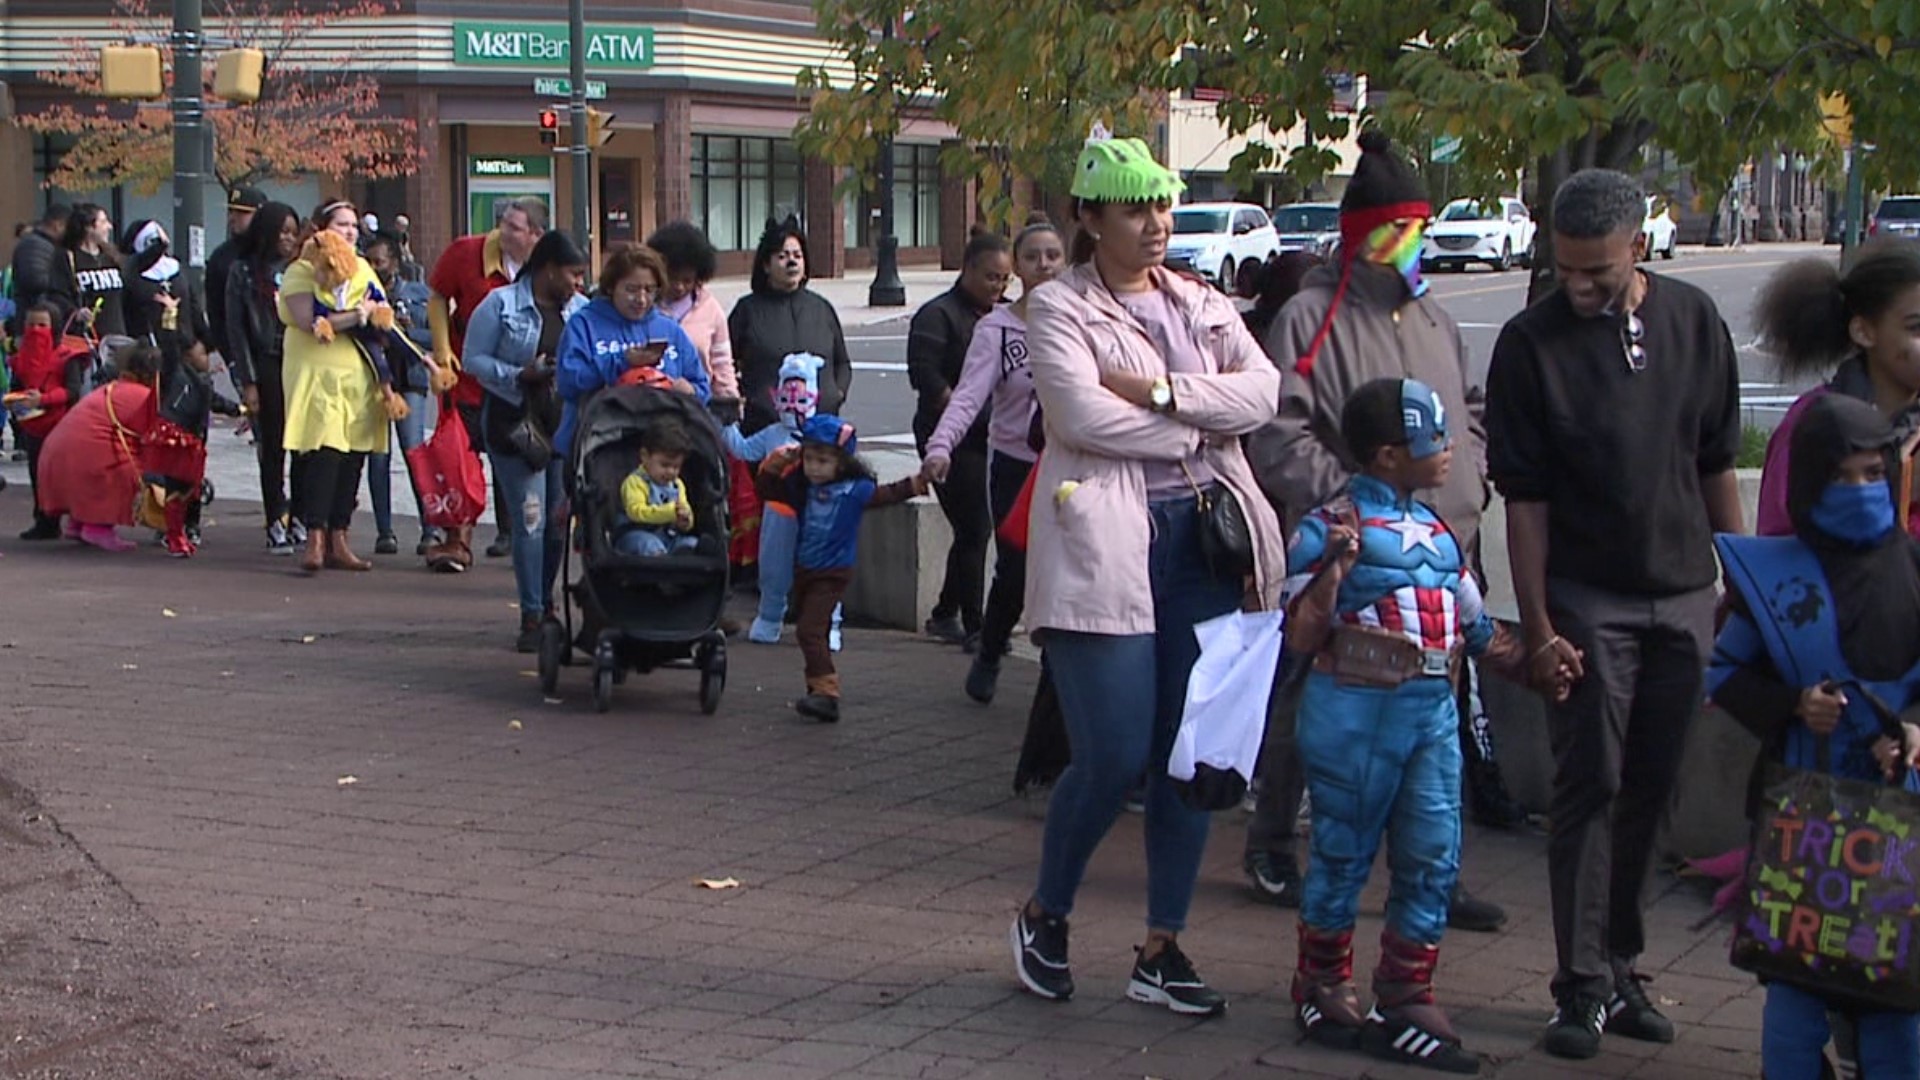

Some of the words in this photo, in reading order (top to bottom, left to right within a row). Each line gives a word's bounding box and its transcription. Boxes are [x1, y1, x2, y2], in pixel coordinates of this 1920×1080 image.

[466, 30, 527, 57] M&T
[529, 33, 571, 58] Ban
[586, 34, 645, 61] ATM
[76, 267, 124, 291] PINK
